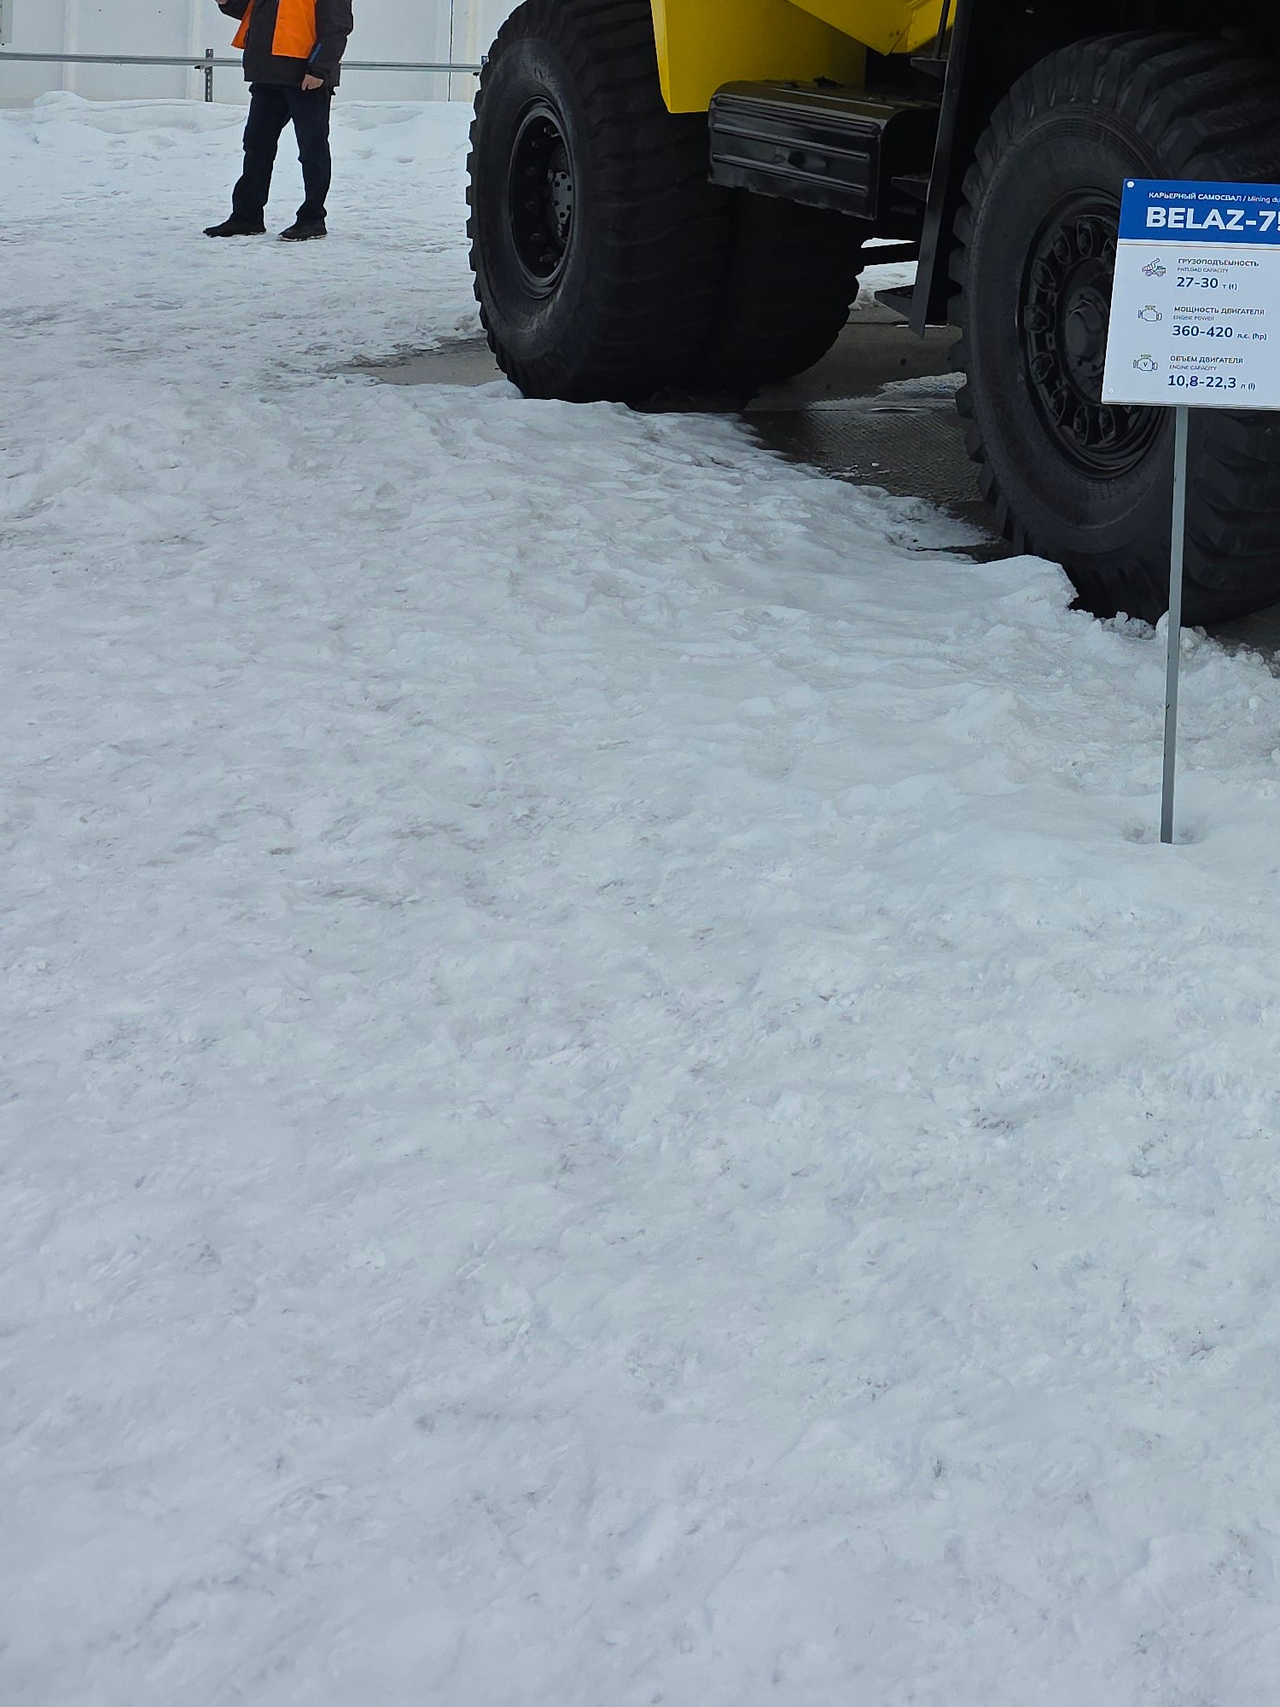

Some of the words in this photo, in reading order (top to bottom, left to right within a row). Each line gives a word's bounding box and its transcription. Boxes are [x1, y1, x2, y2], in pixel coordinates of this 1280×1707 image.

[1148, 192, 1197, 200] КАРЬЕРНЫЙ
[1198, 193, 1242, 202] САМОСВАЛ
[1248, 196, 1270, 204] Mining
[1177, 276, 1219, 288] 27-30
[1174, 306, 1219, 314] МОЩНОСТЬ
[1221, 307, 1265, 315] ДВИГАТЕЛЯ
[1172, 325, 1233, 338] 360-420
[1252, 332, 1267, 340] (hp)
[1199, 356, 1243, 364] ДВИГАТЕЛЯ
[1168, 374, 1237, 390] 10,8-22,3
